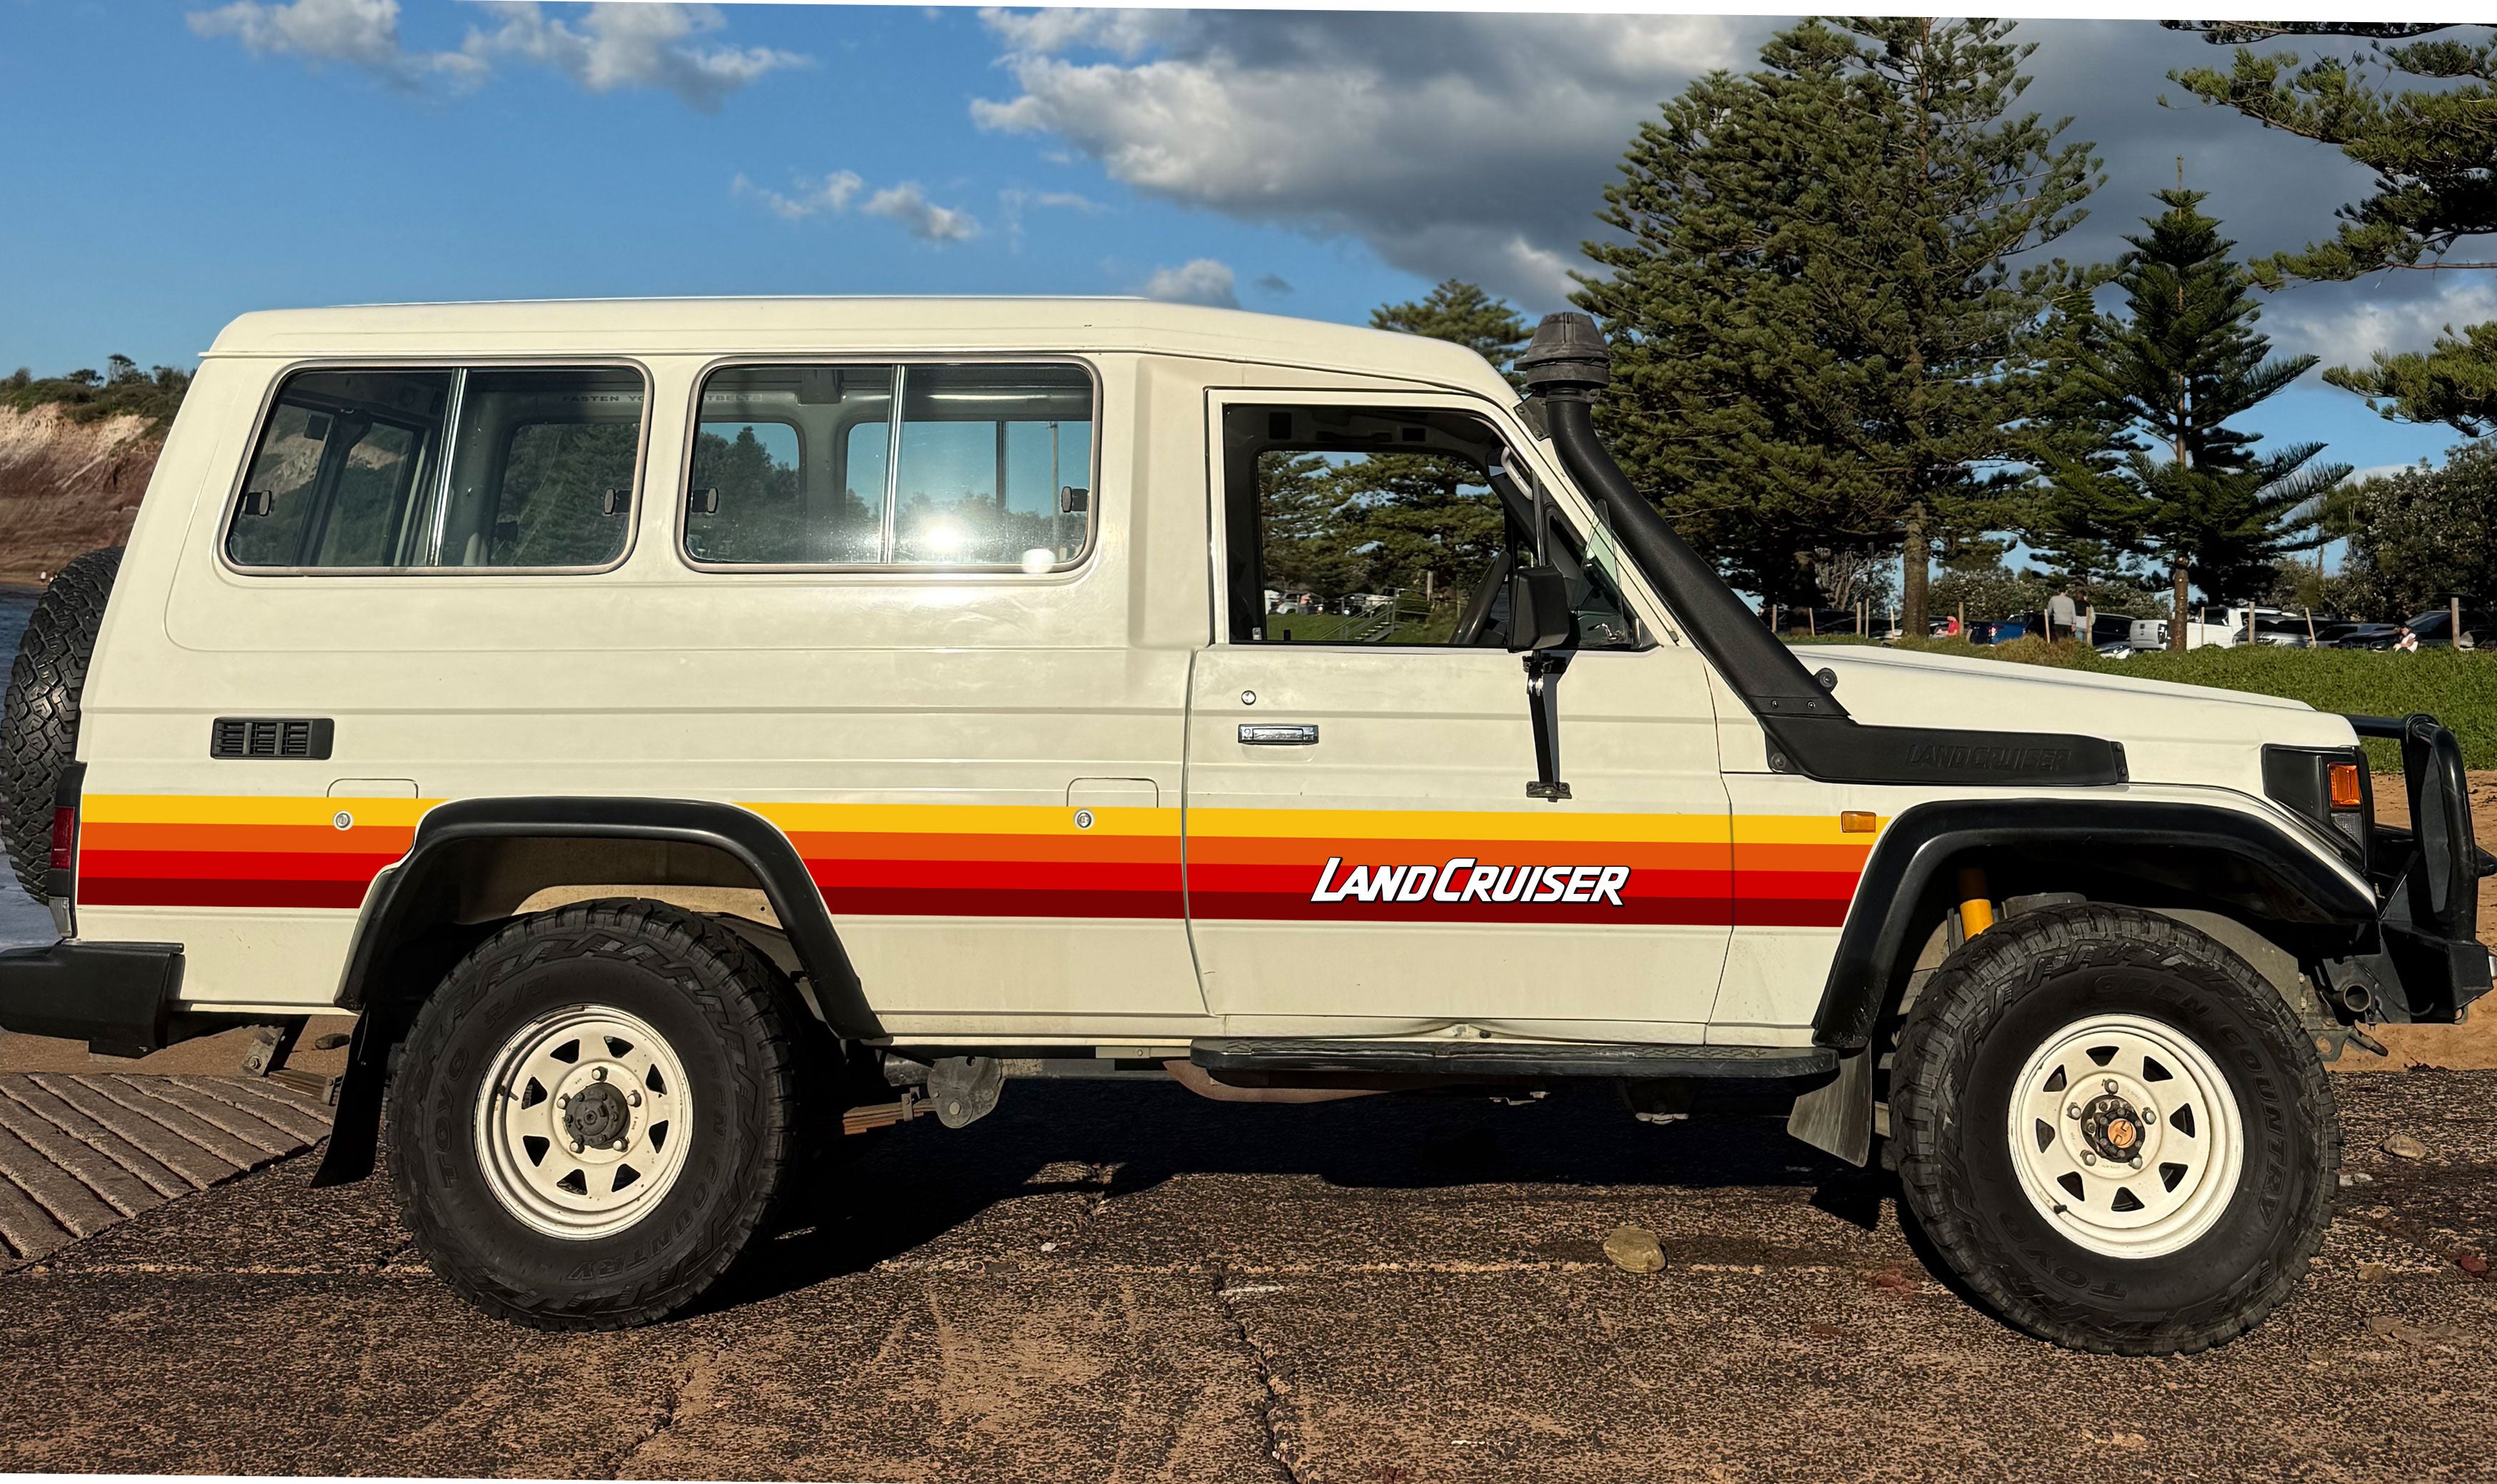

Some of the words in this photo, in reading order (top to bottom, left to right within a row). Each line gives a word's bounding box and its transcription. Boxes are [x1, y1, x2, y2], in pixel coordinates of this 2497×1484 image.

[1310, 856, 1632, 907] LANDCRUISER
[432, 1046, 470, 1189] TOYO
[2094, 974, 2213, 1018] OPEN
[2216, 1023, 2289, 1226] COUNTRY
[565, 1154, 721, 1281] COUNTRY
[1998, 1211, 2128, 1302] TOYO
